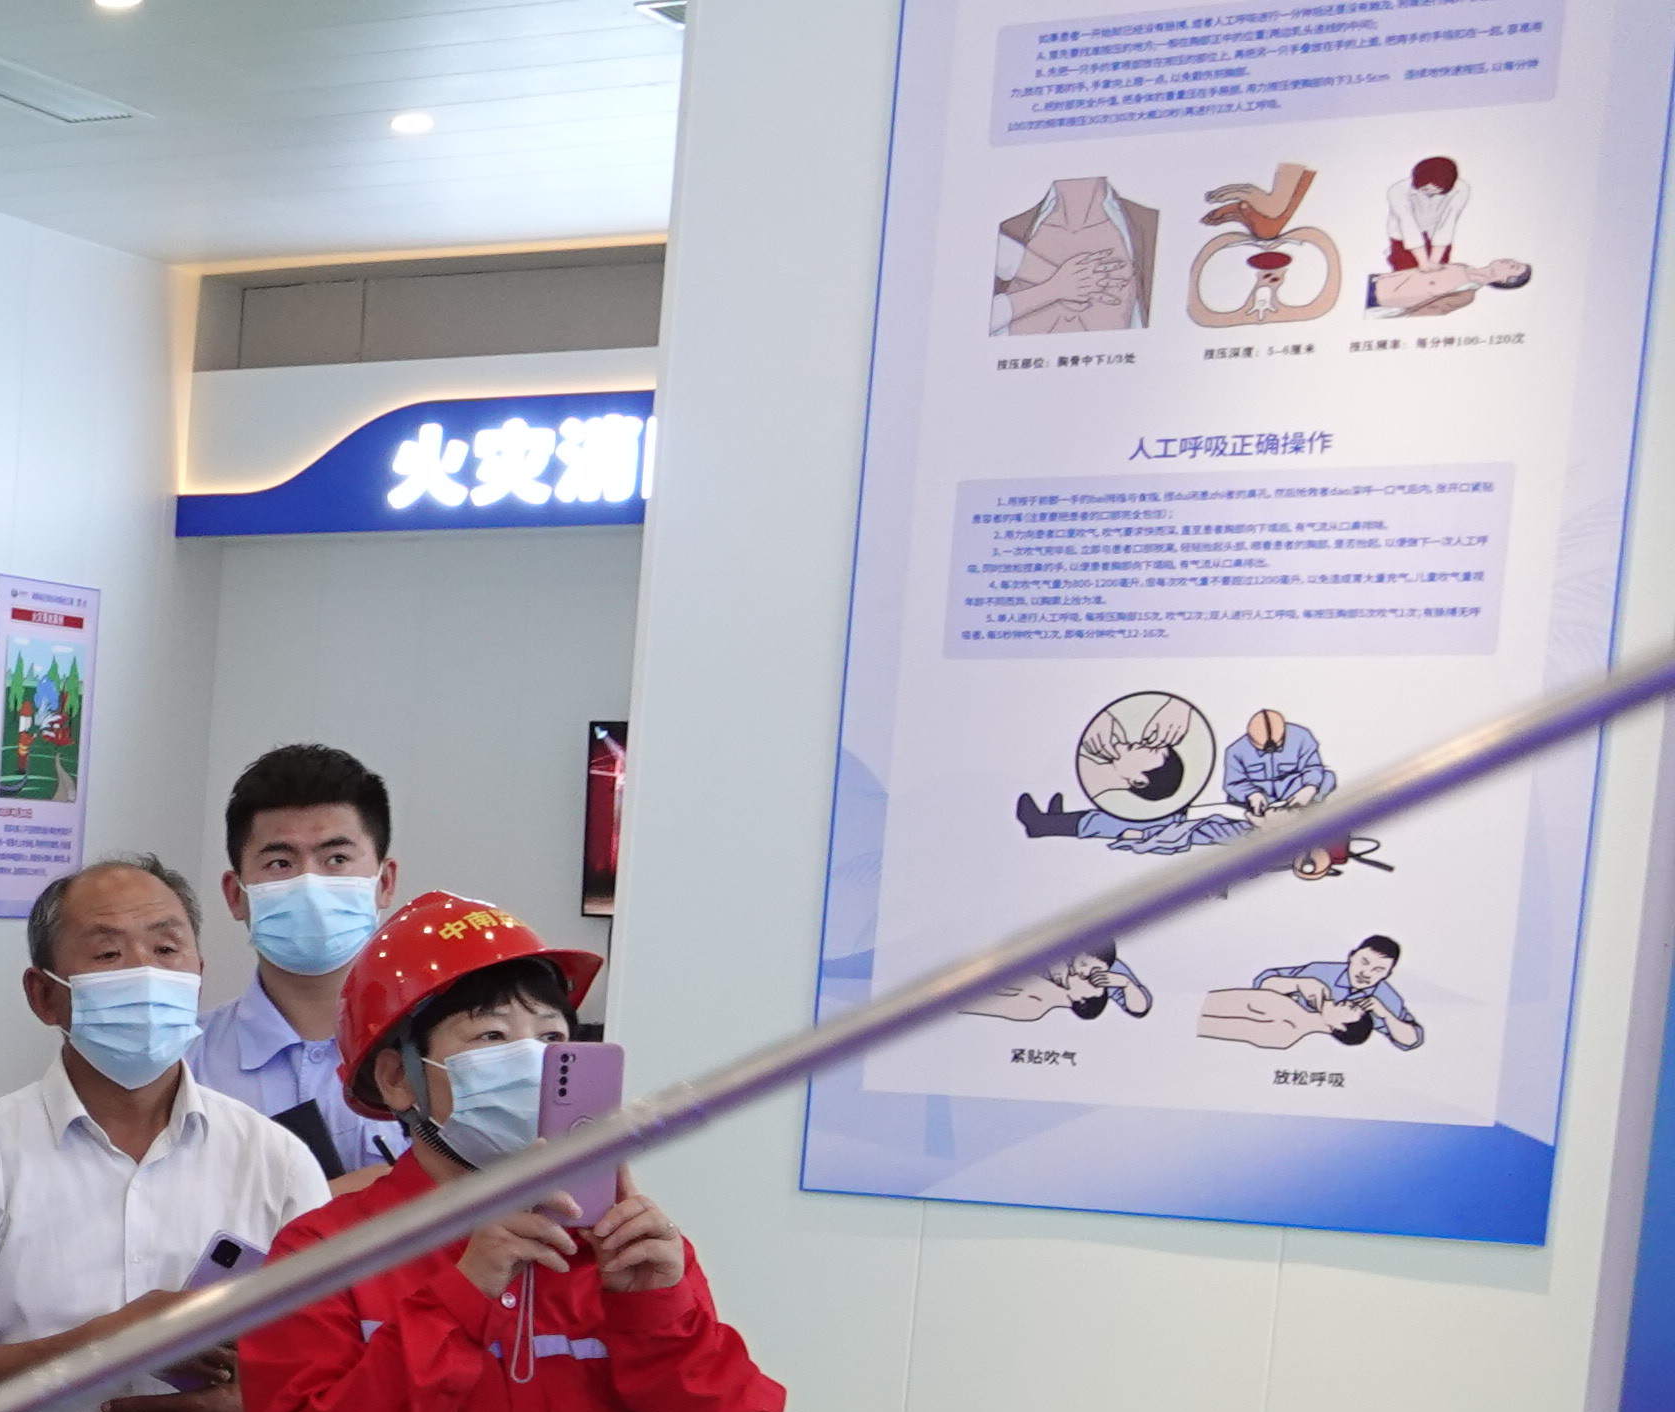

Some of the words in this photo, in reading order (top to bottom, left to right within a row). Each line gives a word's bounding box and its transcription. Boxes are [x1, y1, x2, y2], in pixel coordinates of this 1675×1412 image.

[1128, 430, 1336, 462] 人工呼吸正确操作
[387, 413, 657, 510] 火灾消
[1010, 1047, 1078, 1067] 紧贴吹气
[1272, 1069, 1347, 1088] 放松呼吸
